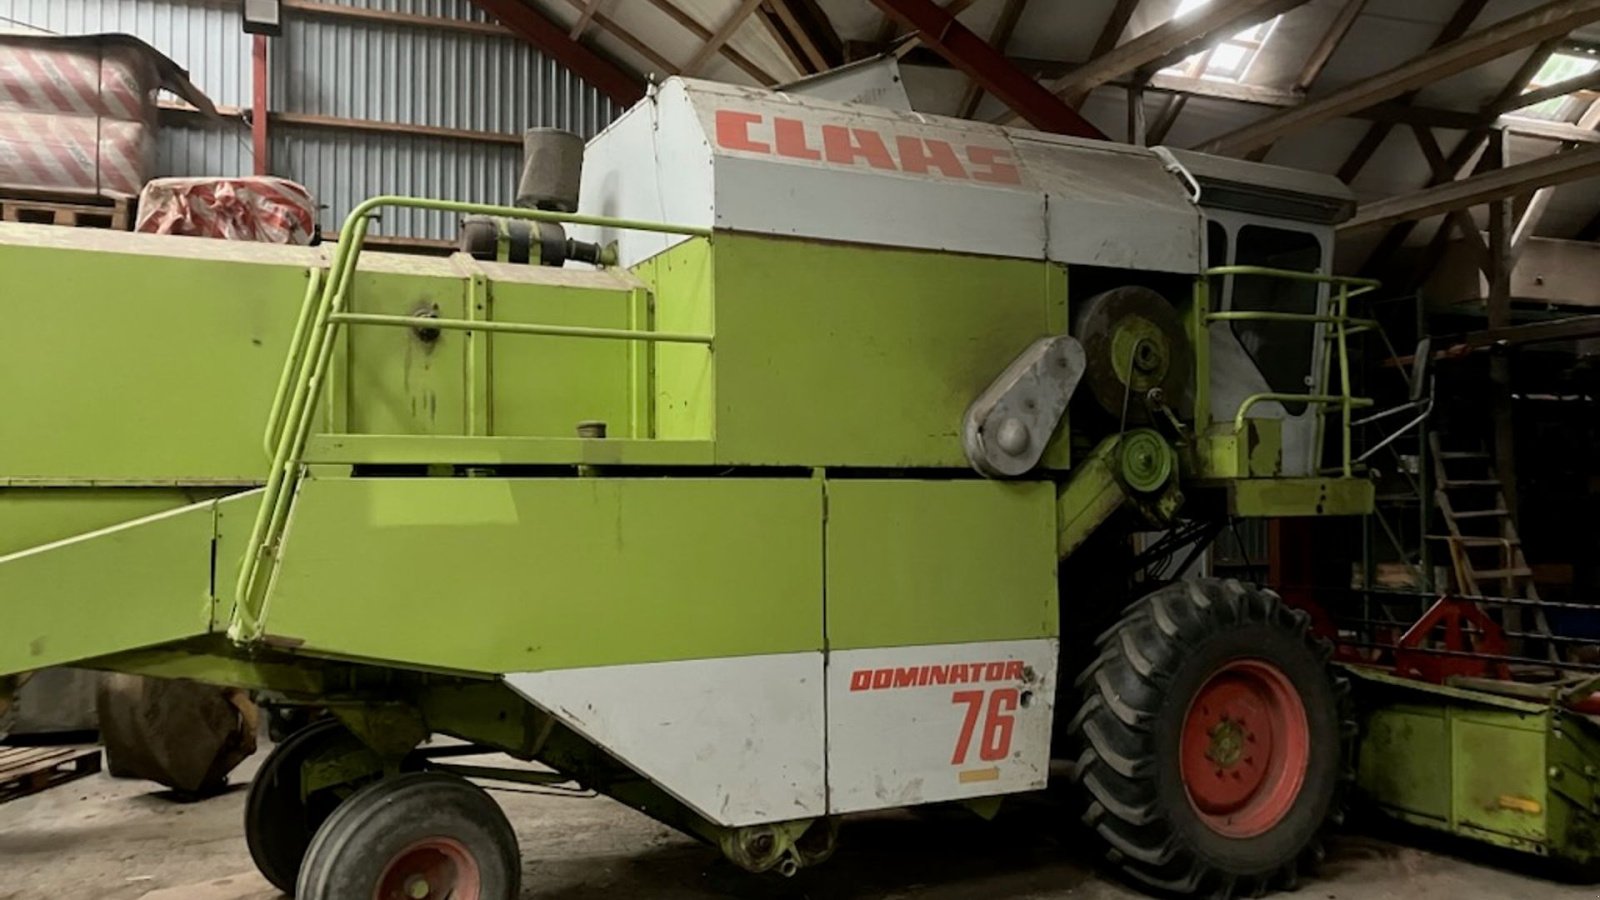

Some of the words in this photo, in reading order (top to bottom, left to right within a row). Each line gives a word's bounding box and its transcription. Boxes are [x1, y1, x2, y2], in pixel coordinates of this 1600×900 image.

[715, 110, 1021, 185] CLAAS
[850, 661, 1024, 691] DOMINATOR
[951, 688, 1019, 765] 76
